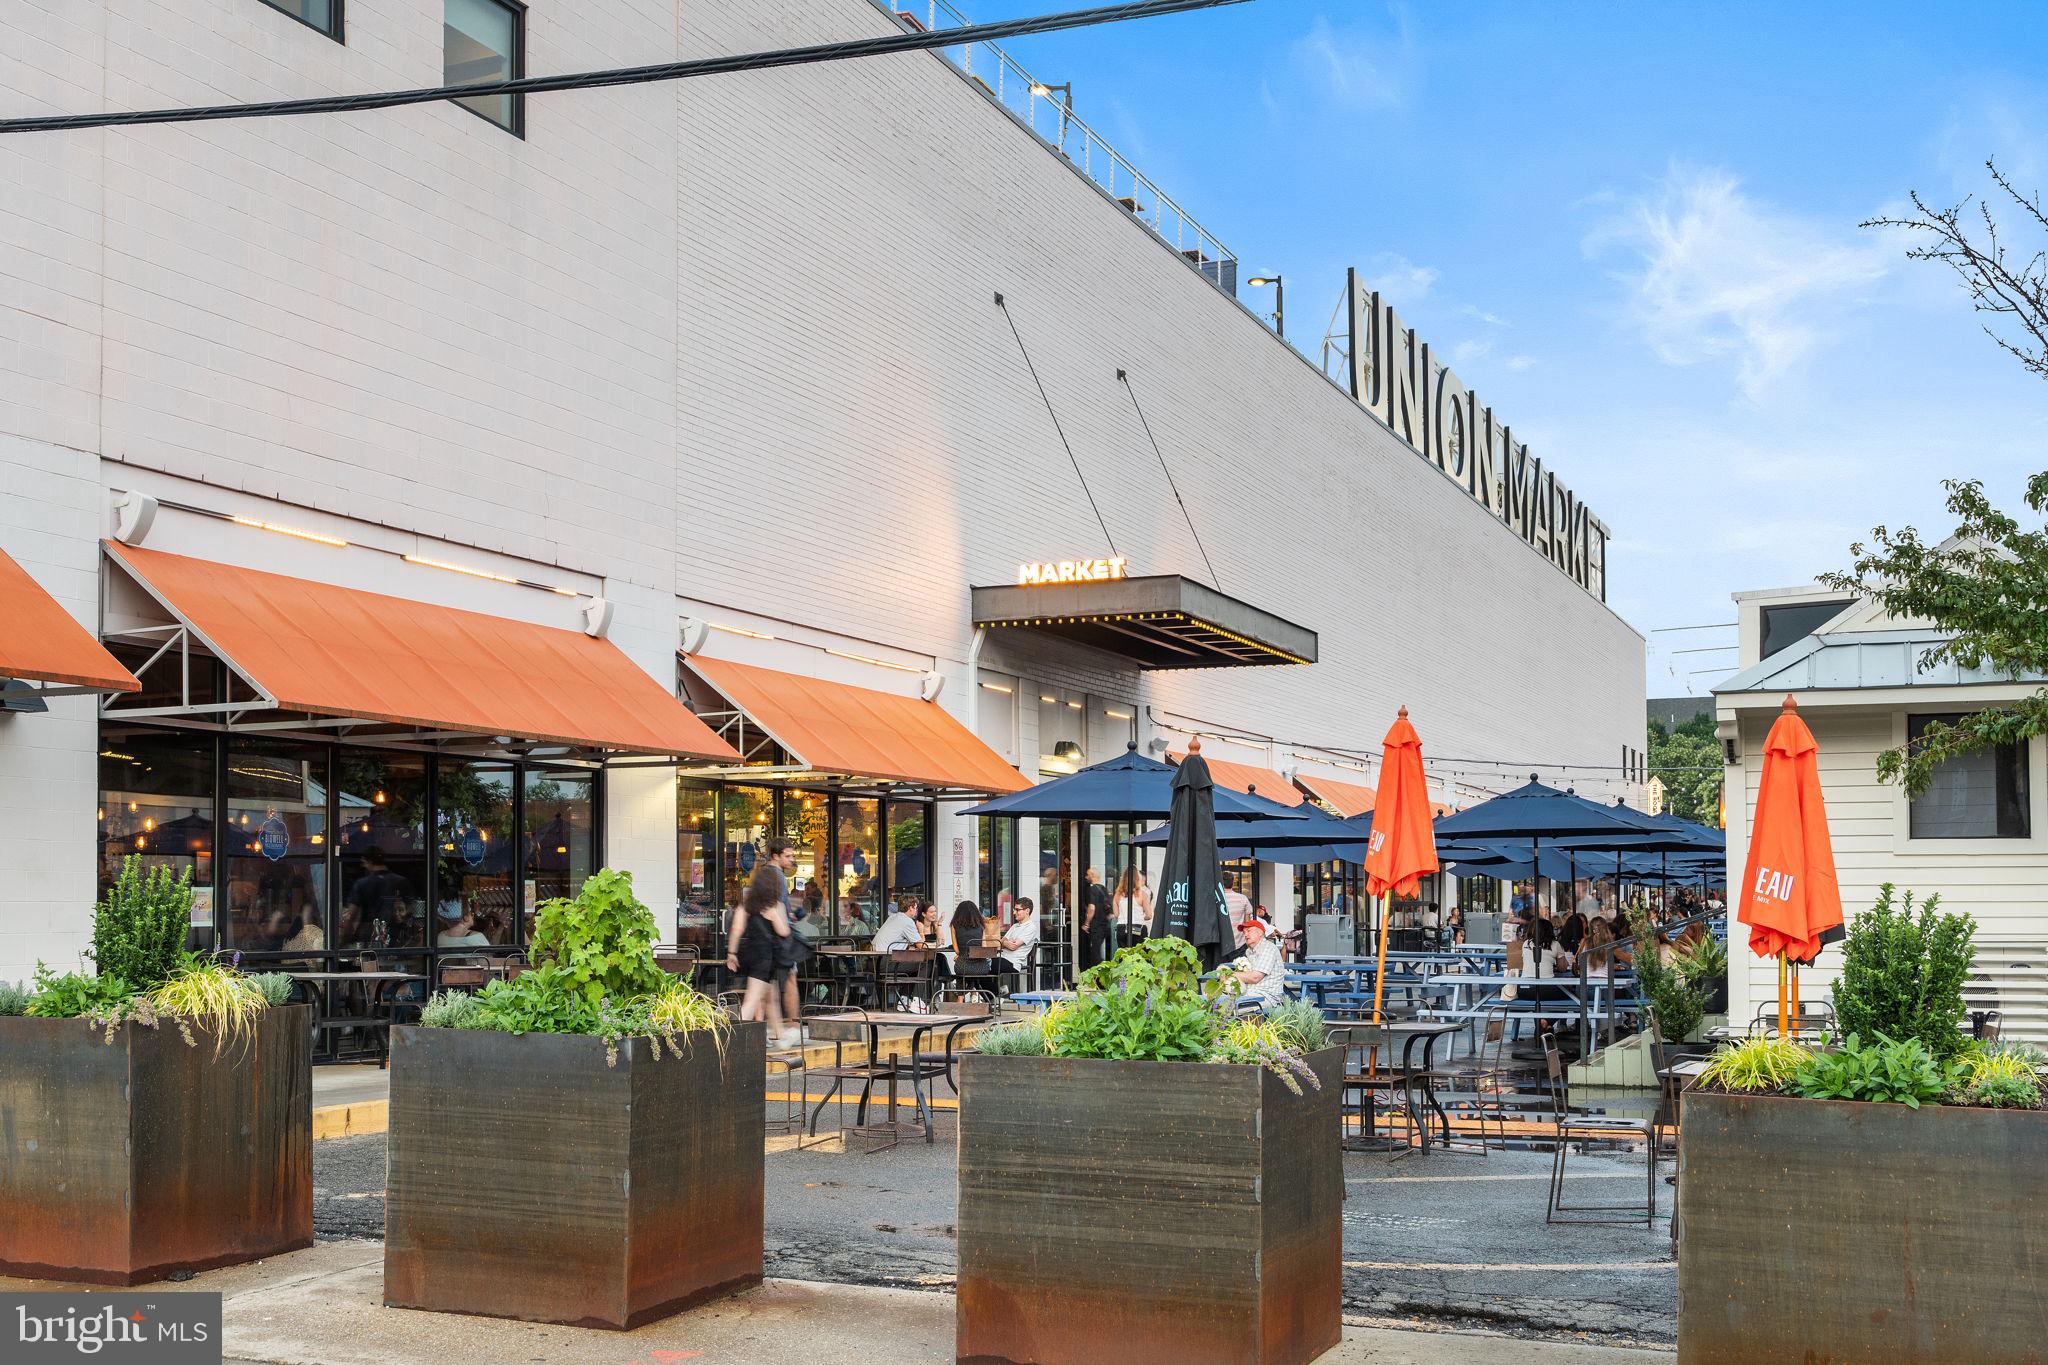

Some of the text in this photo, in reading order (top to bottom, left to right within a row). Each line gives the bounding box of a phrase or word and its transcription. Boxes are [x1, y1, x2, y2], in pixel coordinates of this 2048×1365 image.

[1348, 267, 1501, 518] UNION
[1019, 557, 1126, 585] MARKET
[1755, 867, 1794, 902] EAU
